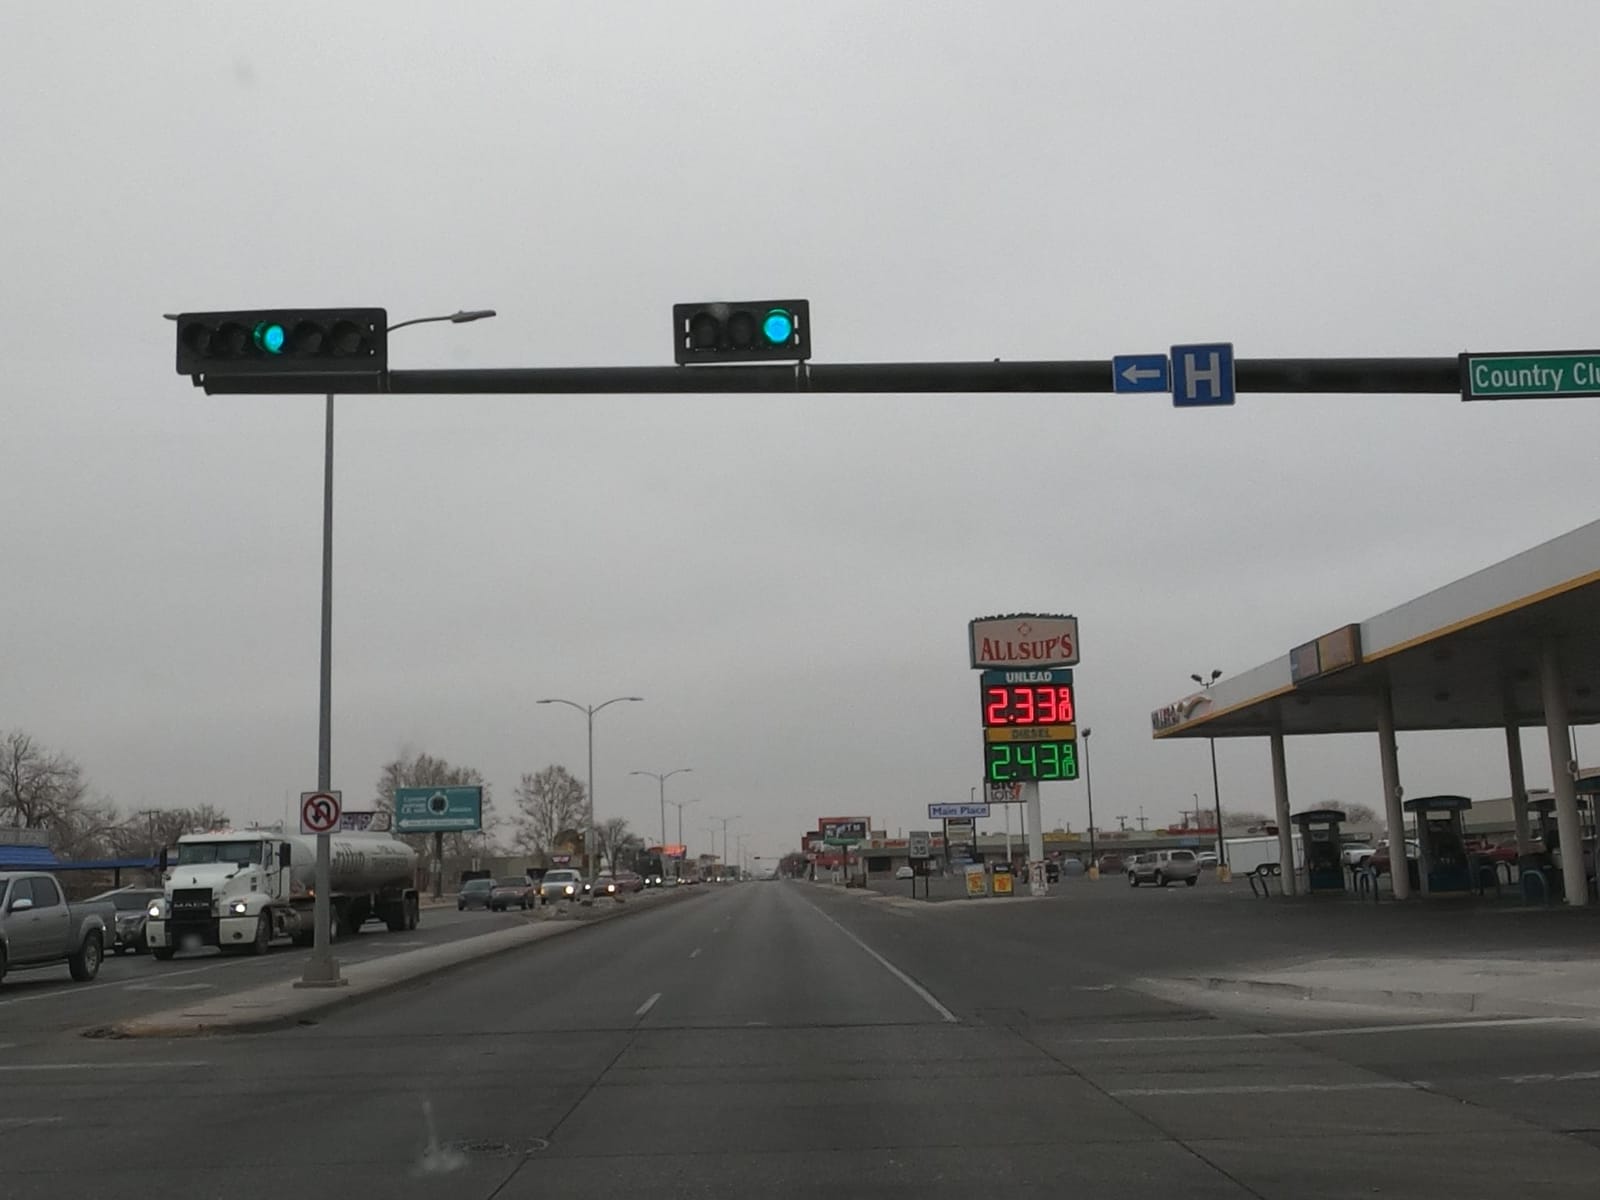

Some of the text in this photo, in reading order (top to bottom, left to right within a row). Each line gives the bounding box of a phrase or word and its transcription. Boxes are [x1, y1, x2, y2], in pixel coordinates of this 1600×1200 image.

[1184, 352, 1221, 398] H
[1475, 364, 1564, 391] Country
[980, 633, 1073, 661] ALLSUP'S
[1005, 671, 1052, 684] UNLEAD
[931, 806, 987, 816] Main Place
